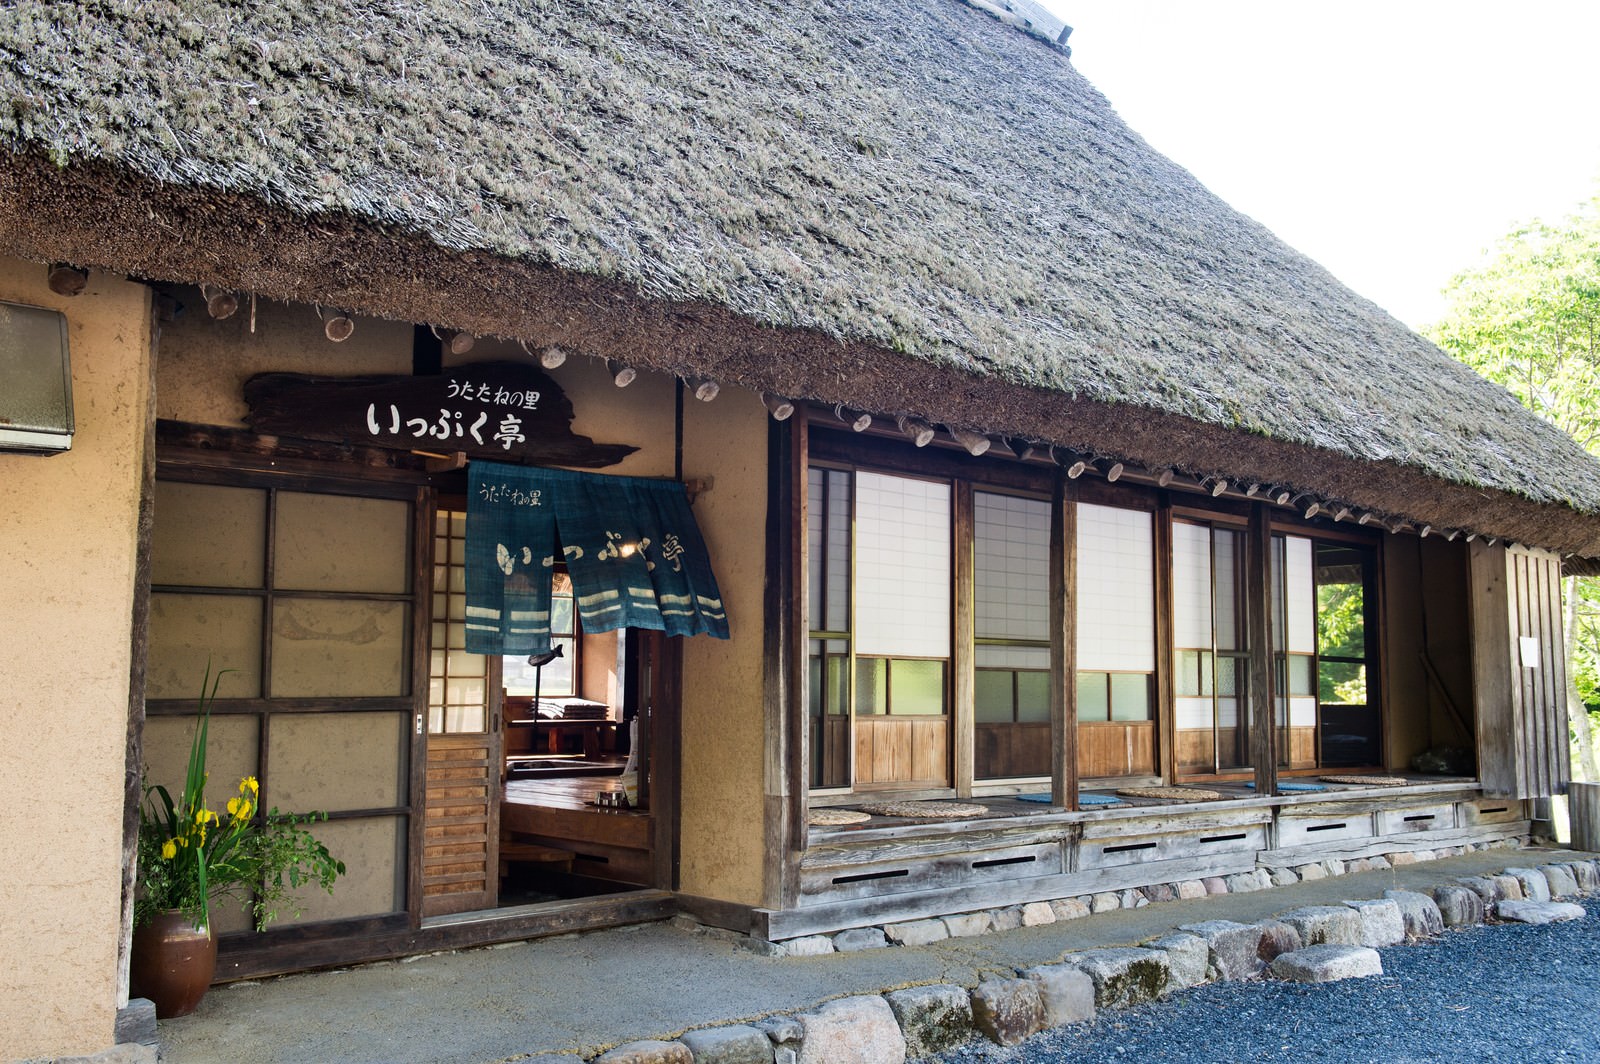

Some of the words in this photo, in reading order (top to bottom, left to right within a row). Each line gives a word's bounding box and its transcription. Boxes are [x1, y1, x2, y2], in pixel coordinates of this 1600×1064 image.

[447, 379, 541, 410] うたたねの里
[366, 402, 526, 450] いっぷく亭
[480, 483, 542, 506] うたたねの里
